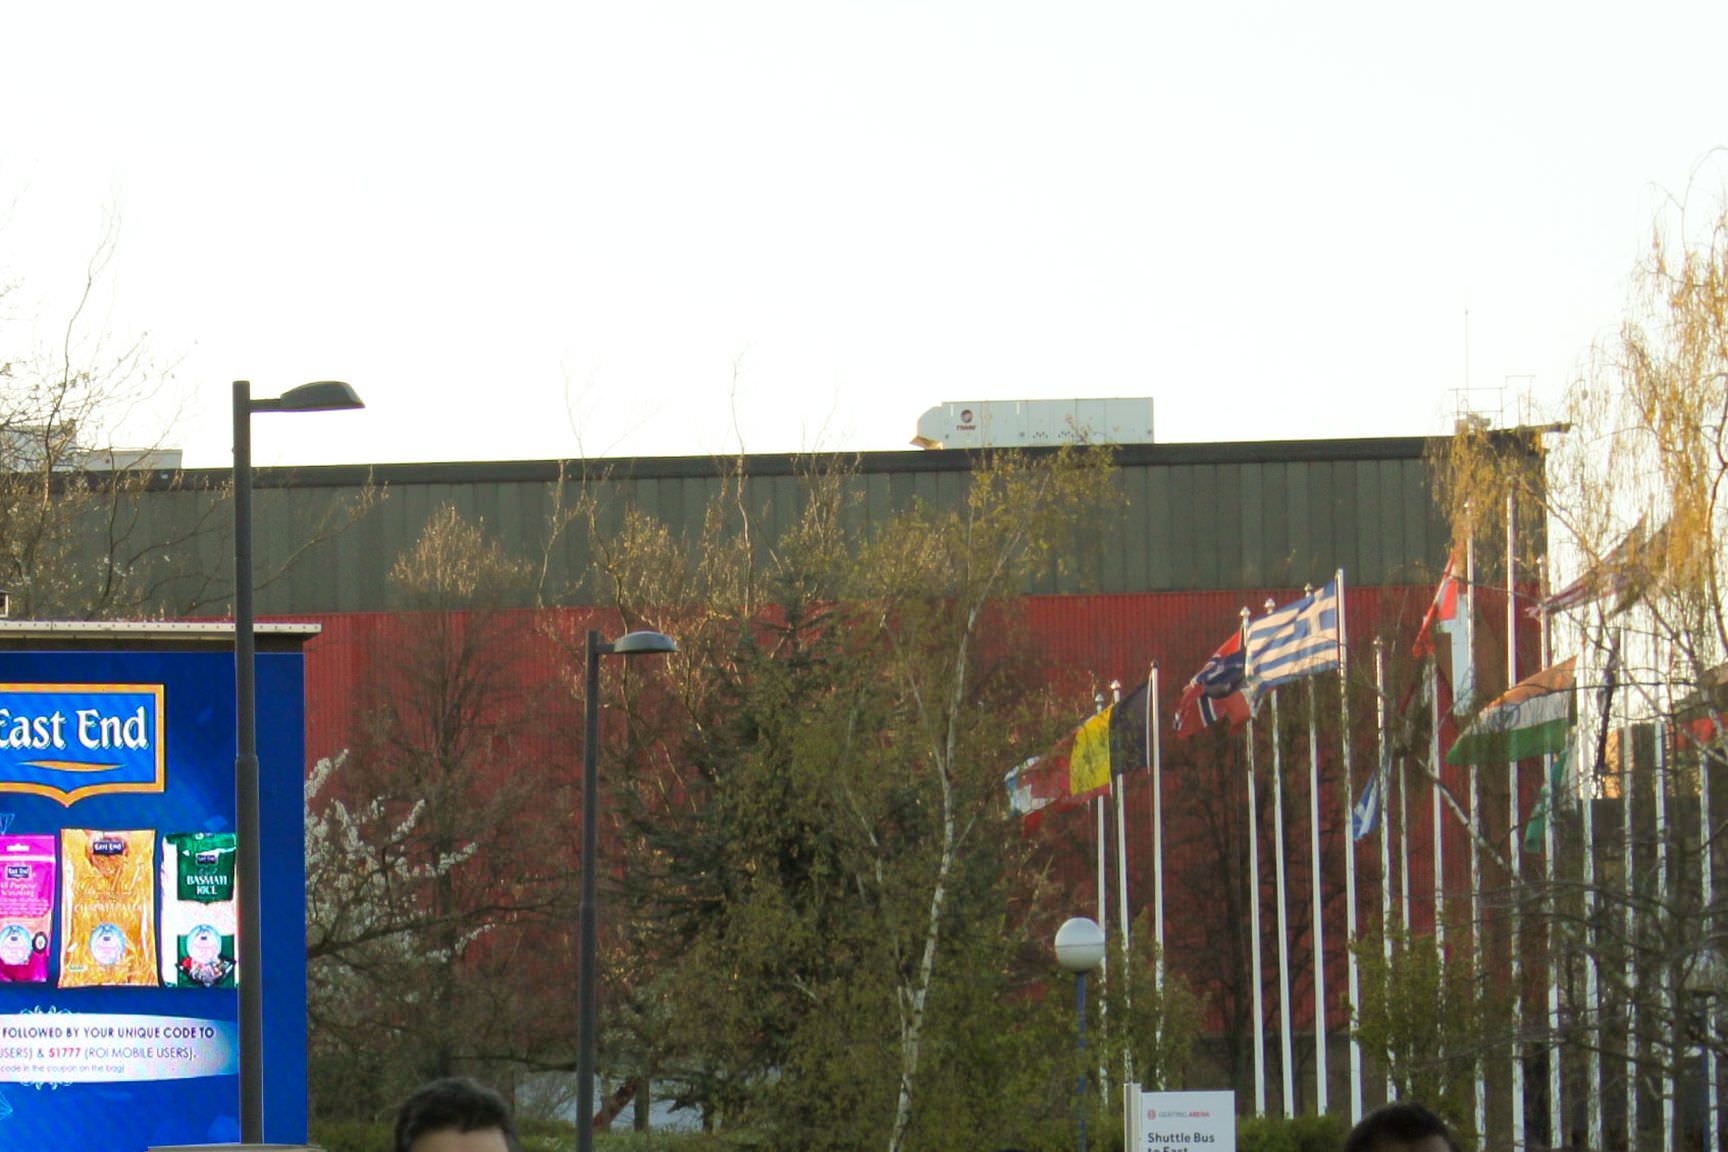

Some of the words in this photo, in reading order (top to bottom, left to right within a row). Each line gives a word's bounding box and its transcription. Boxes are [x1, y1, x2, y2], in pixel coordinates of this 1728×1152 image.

[75, 705, 151, 750] End
[187, 875, 228, 885] BASMATI
[196, 885, 218, 895] RICE
[2, 1027, 63, 1039] FOLLOWED
[66, 1027, 80, 1039] BY
[84, 1027, 114, 1039] YOUR
[118, 1027, 160, 1039] UNIQUE
[163, 1027, 197, 1039] CODE
[198, 1027, 215, 1039] TO
[37, 1048, 45, 1059] &
[49, 1047, 81, 1058] 51777
[112, 1047, 153, 1059] MOBILE
[1147, 1132, 1191, 1144] Shuttle
[1193, 1132, 1215, 1144] Bus
